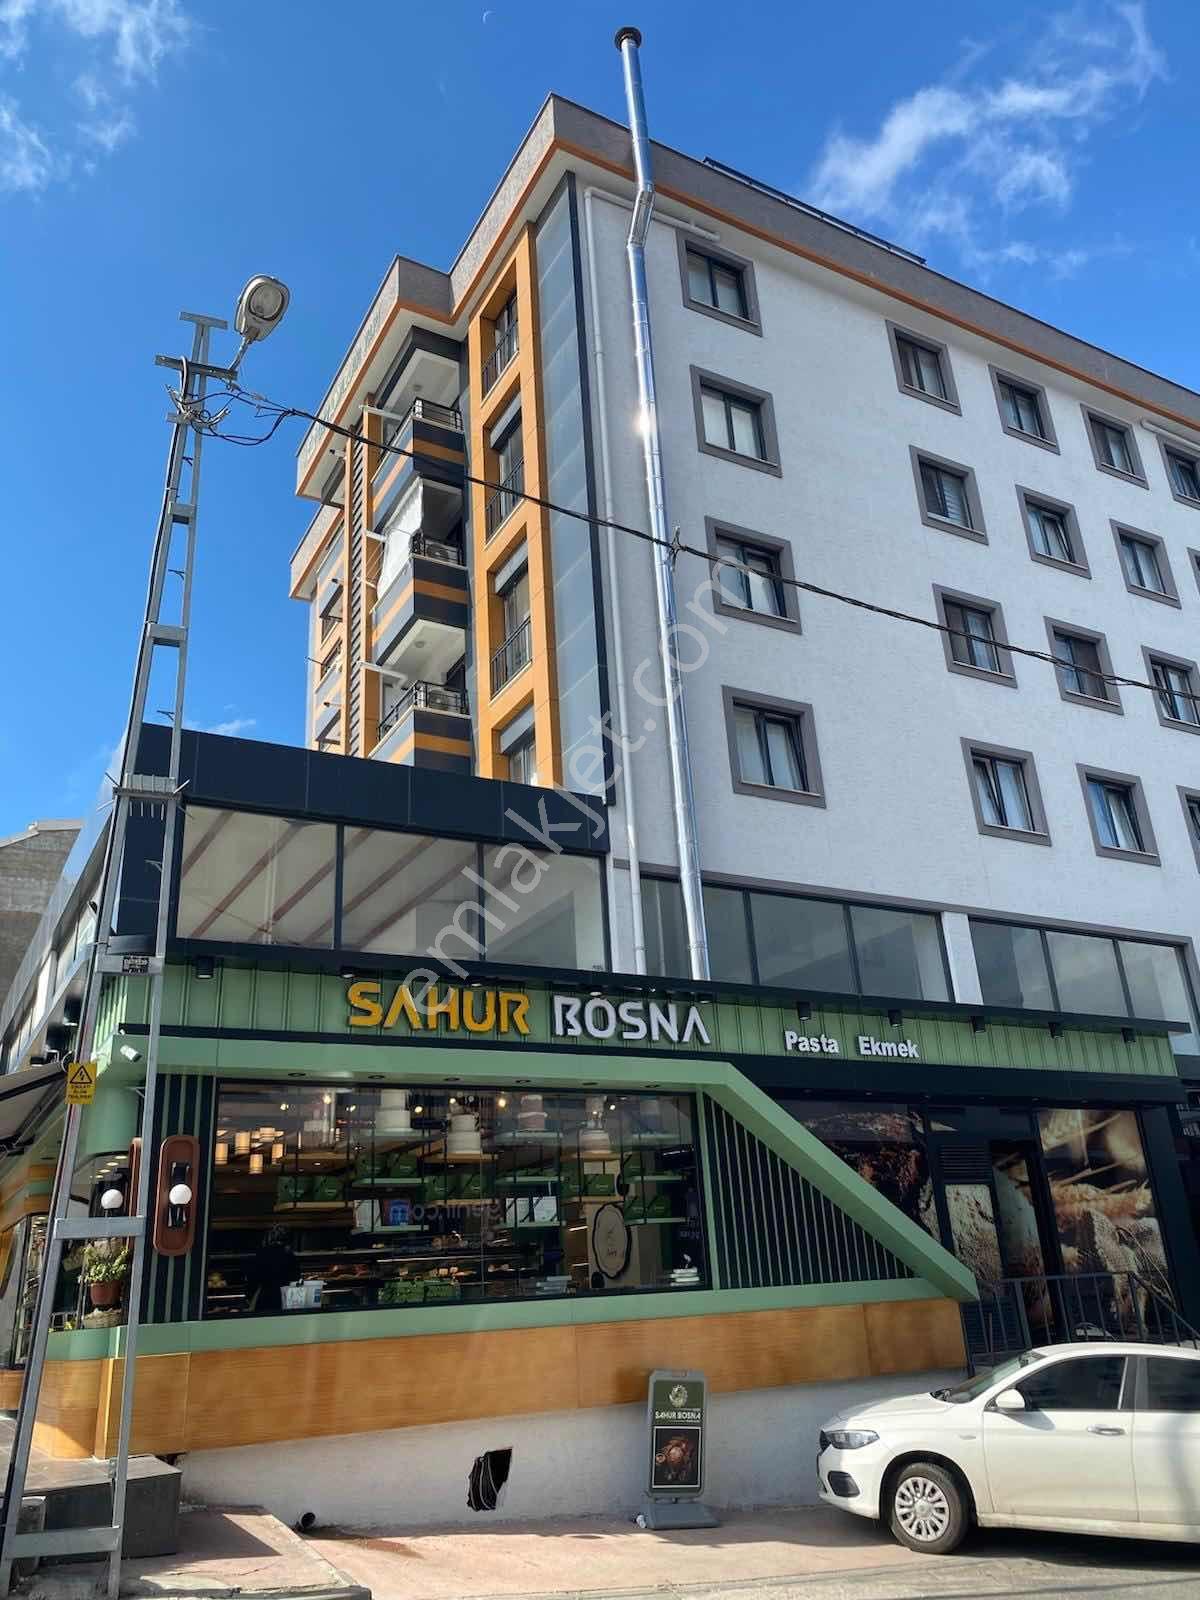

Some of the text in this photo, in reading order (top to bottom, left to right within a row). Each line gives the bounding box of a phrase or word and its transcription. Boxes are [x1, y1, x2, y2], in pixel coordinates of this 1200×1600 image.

[347, 981, 711, 1044] SAHUR BOSNA
[784, 1030, 920, 1058] Pasta Ekmek
[654, 1410, 701, 1420] SAHUR BOSNA
